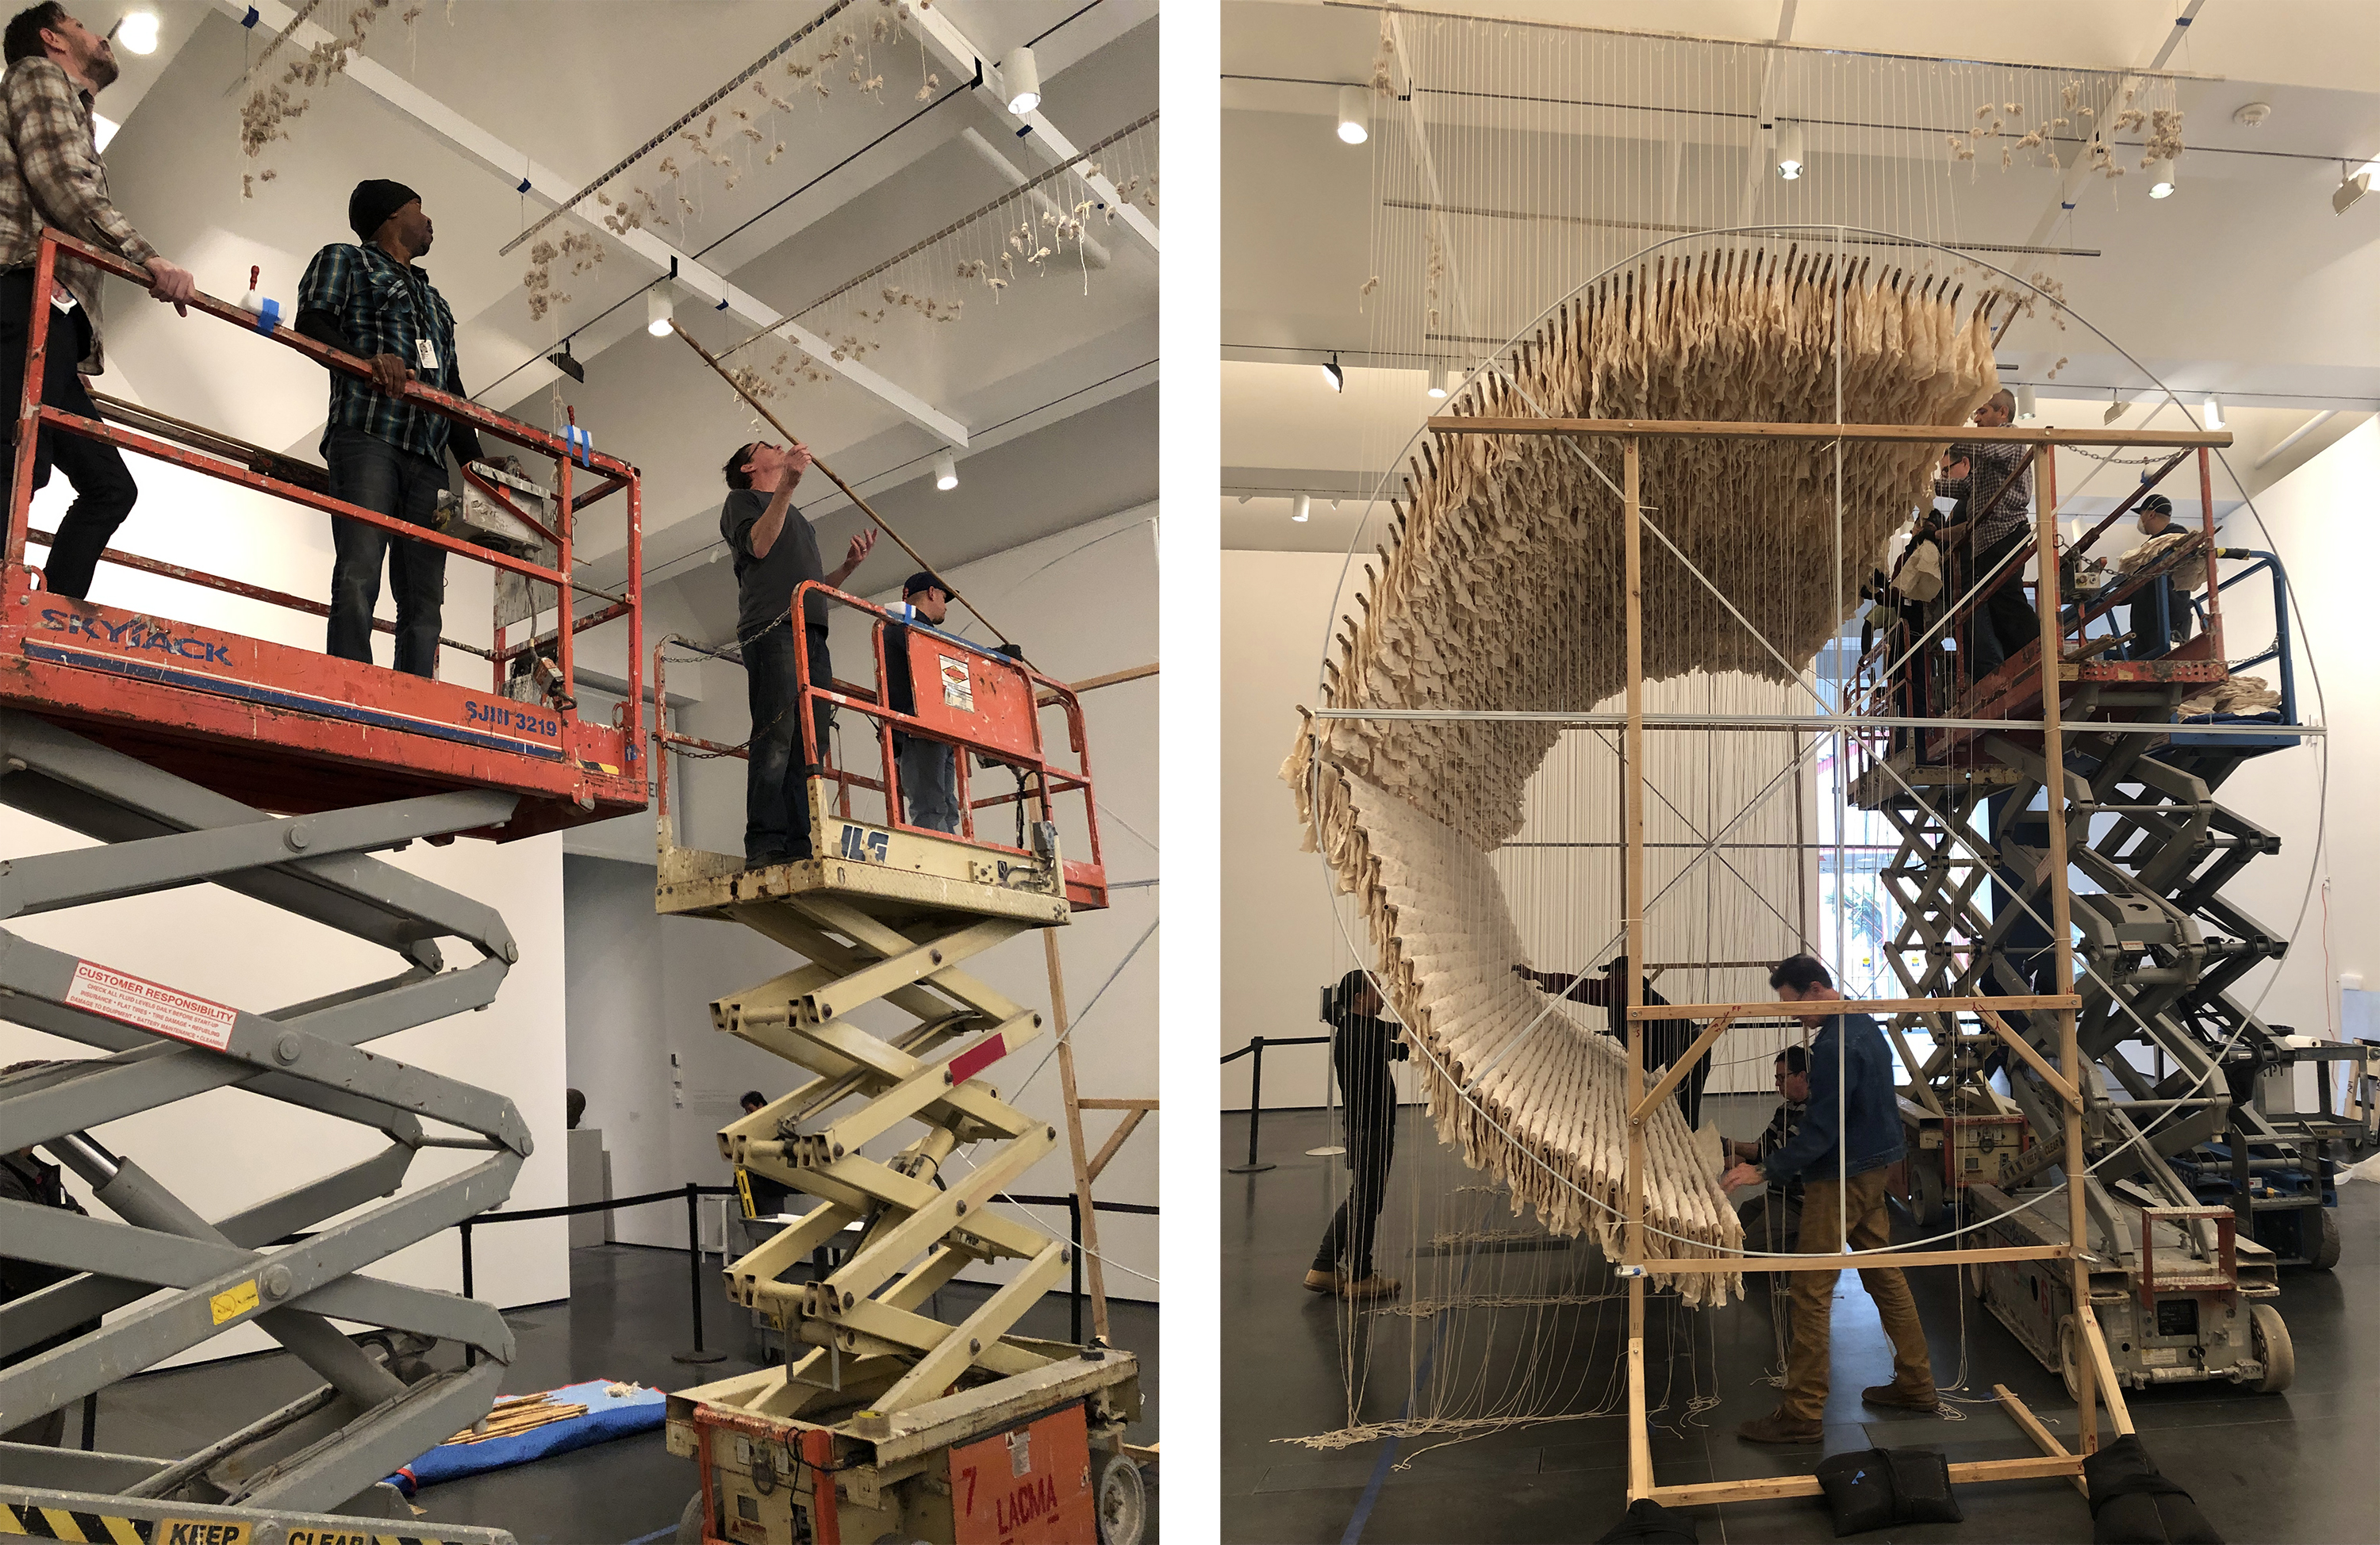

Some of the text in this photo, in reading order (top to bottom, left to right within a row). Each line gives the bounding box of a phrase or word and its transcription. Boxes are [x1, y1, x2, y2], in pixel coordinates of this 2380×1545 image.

[41, 608, 233, 667] SKYJACK
[516, 713, 557, 737] 3219
[79, 967, 233, 1022] CUSTOMER RESPONSIBILITY
[80, 990, 221, 1038] INSURANCE FLAT TIRES TIRE DAMAGE REFUELING
[86, 983, 106, 993] CHECK
[119, 994, 135, 1003] FLUID
[136, 999, 156, 1010] LEVELS
[156, 1005, 172, 1014] DAILY
[172, 1010, 194, 1022] BEFORE
[194, 1017, 219, 1029] START-UP
[70, 995, 94, 1008] DAMAGE
[102, 1005, 132, 1019] EQUIPMENT
[136, 1016, 160, 1028] BATTERY
[160, 1023, 196, 1039] MAINTENANCE
[199, 1036, 225, 1047] CLEANING
[2040, 1278, 2049, 1317] 6
[962, 1466, 977, 1518] 7
[996, 1473, 1058, 1535] LACMA
[170, 1524, 240, 1545] KEEP
